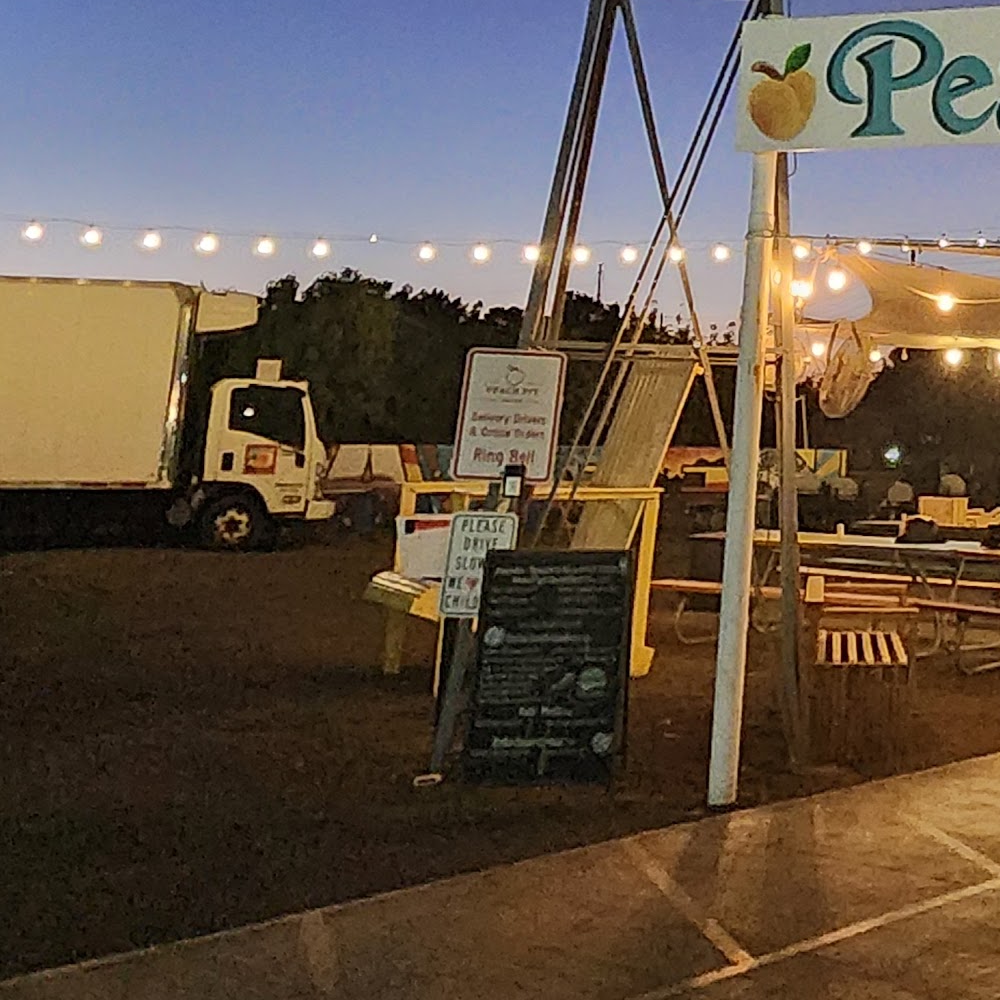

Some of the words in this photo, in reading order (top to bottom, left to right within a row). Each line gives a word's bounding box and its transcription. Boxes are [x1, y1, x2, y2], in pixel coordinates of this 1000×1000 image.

[473, 447, 504, 467] Ring
[509, 448, 536, 465] Bell
[461, 518, 506, 533] PLEASE
